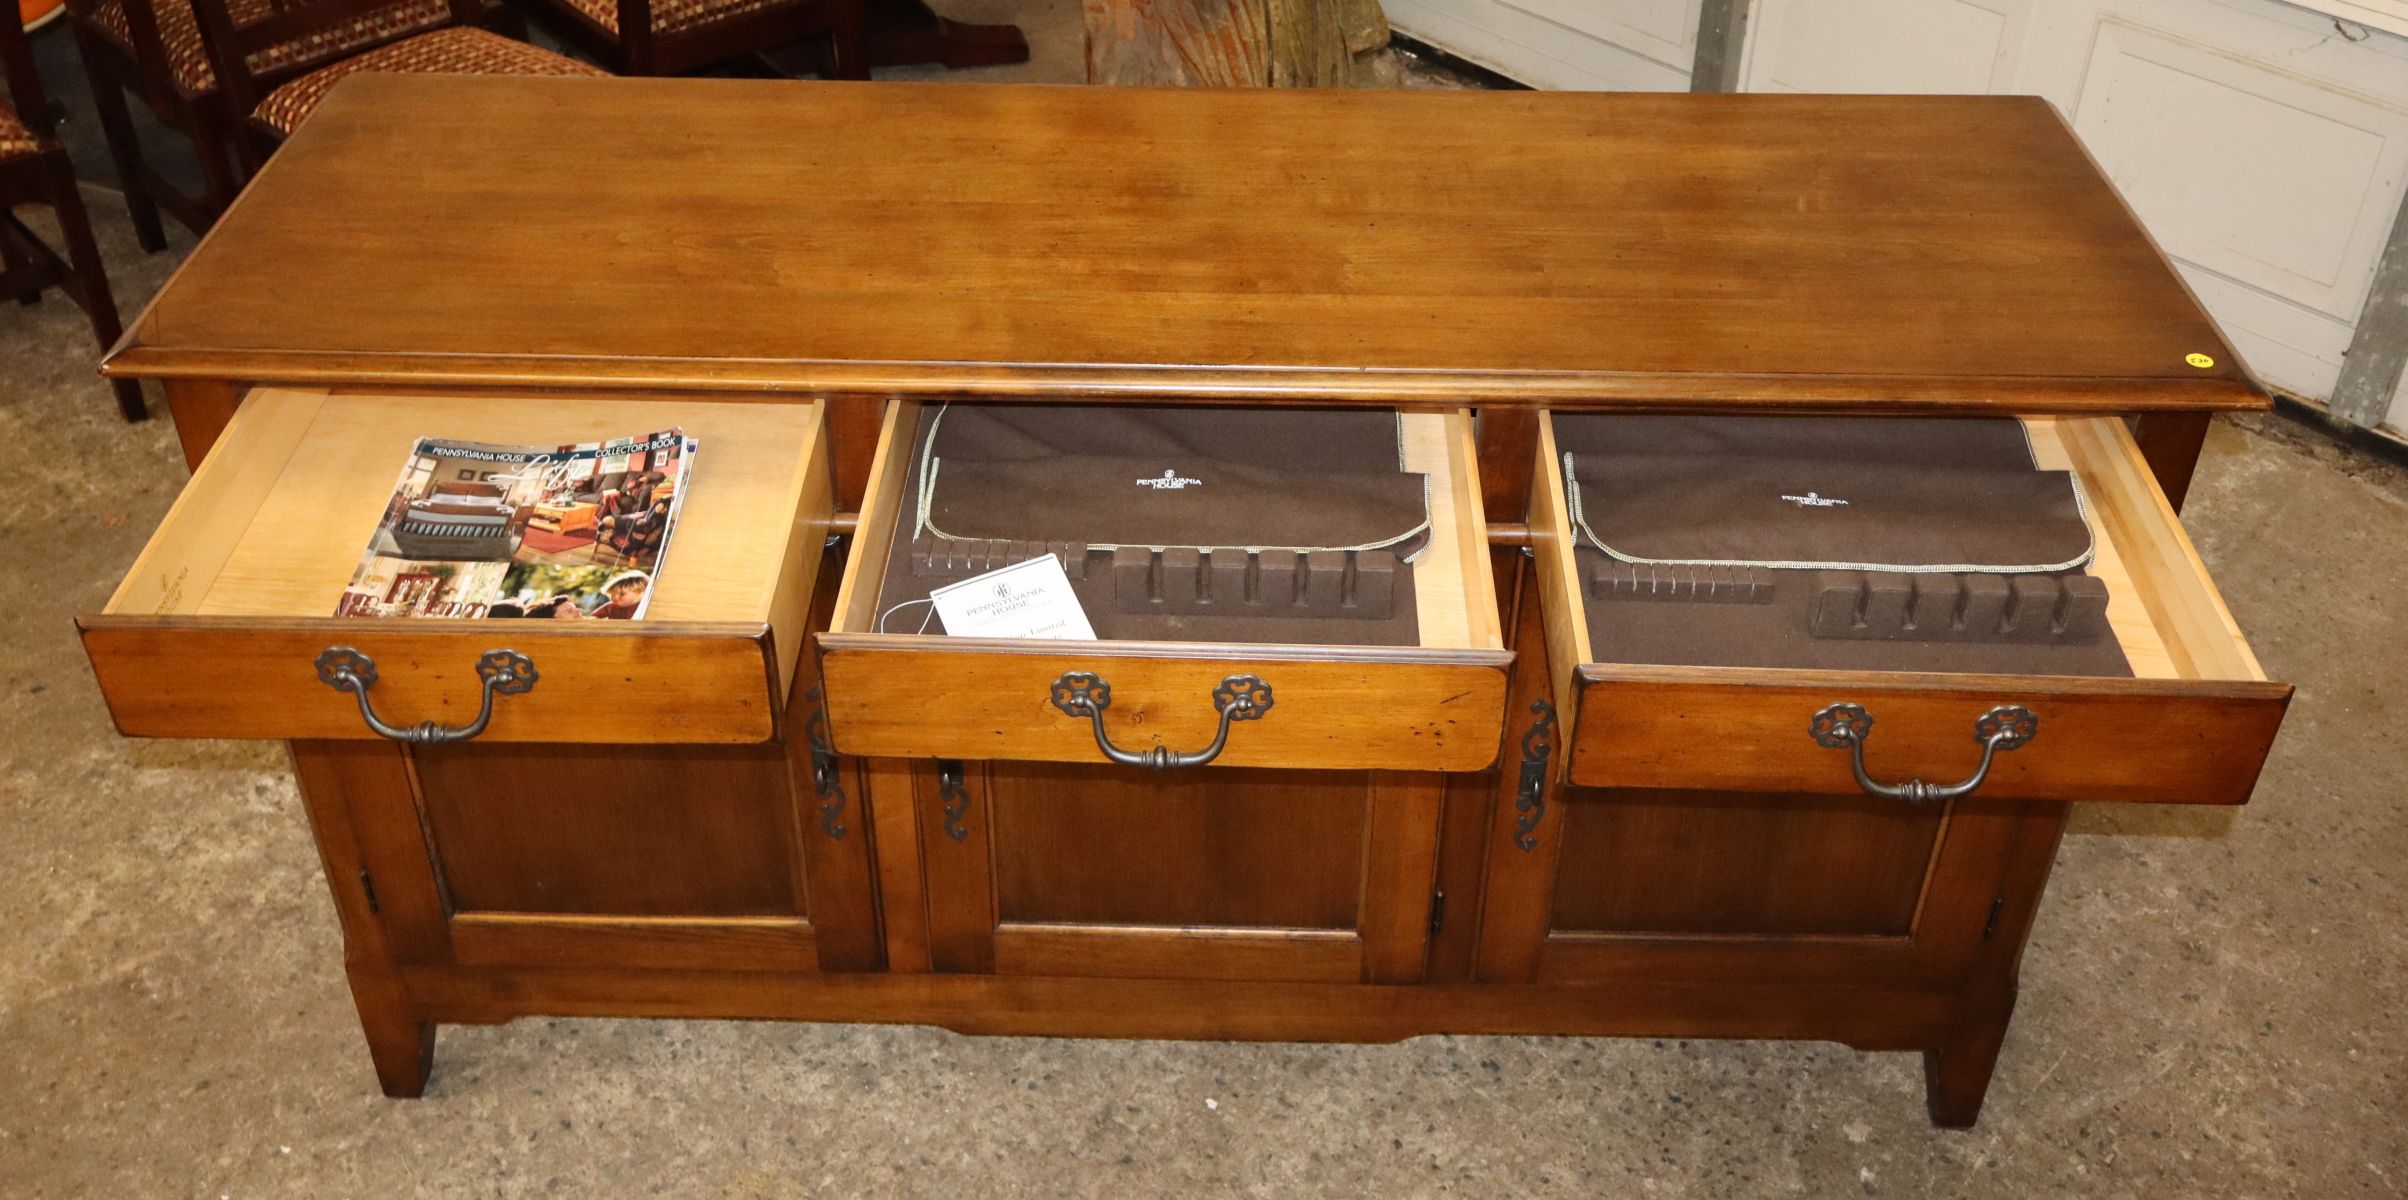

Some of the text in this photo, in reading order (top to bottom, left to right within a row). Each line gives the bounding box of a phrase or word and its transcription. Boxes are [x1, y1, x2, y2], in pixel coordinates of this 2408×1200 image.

[432, 446, 527, 463] PENNSYLVANIA HOUSE
[595, 437, 676, 458] COLLECTOR'S BOOK
[1136, 477, 1202, 486] PENNSYLVANIA
[1152, 482, 1184, 490] HOUSE
[966, 587, 1046, 617] PENNSYLVANIA
[991, 600, 1030, 616] HOUSE
